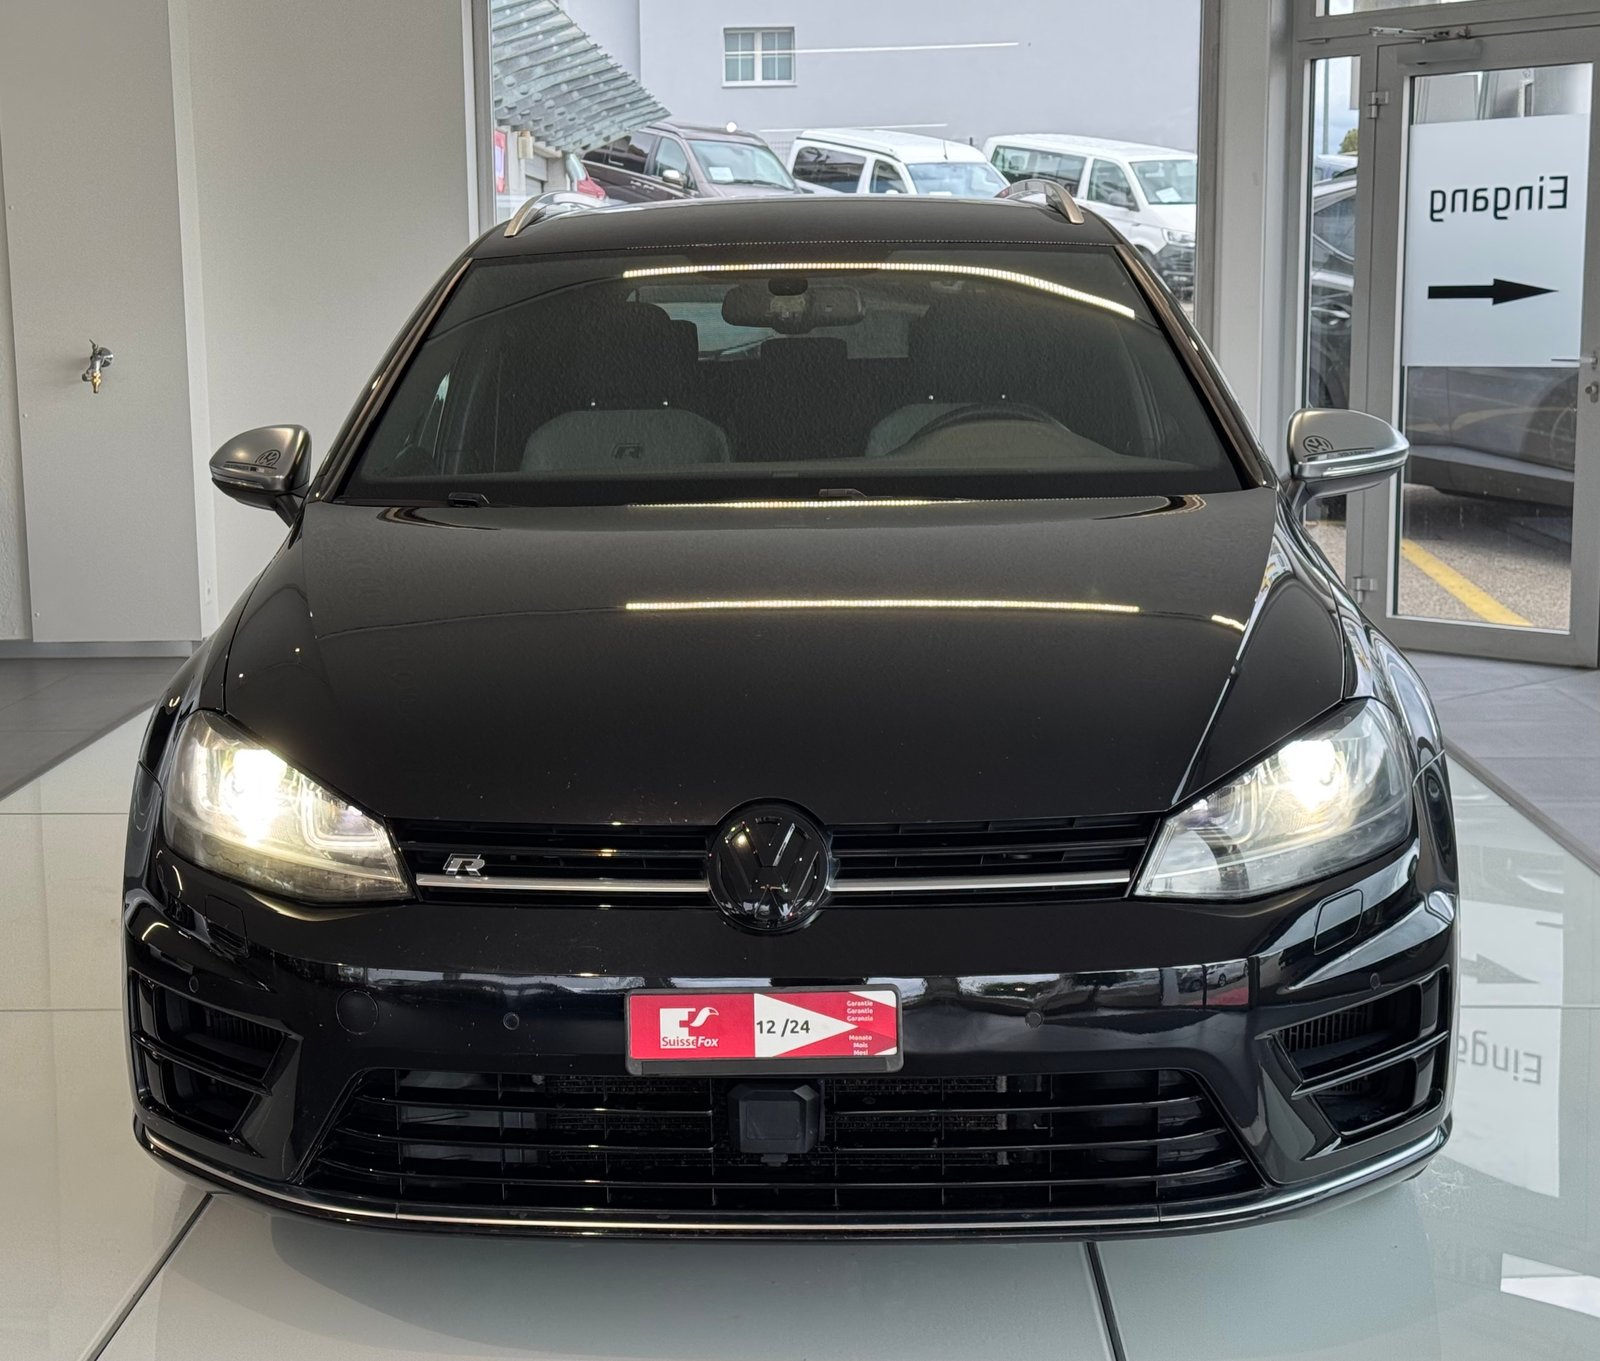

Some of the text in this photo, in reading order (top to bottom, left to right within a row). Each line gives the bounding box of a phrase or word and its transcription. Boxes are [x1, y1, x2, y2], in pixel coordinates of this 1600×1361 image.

[443, 853, 485, 876] R
[756, 1018, 811, 1037] 12 /24
[1457, 1030, 1542, 1085] Einga
